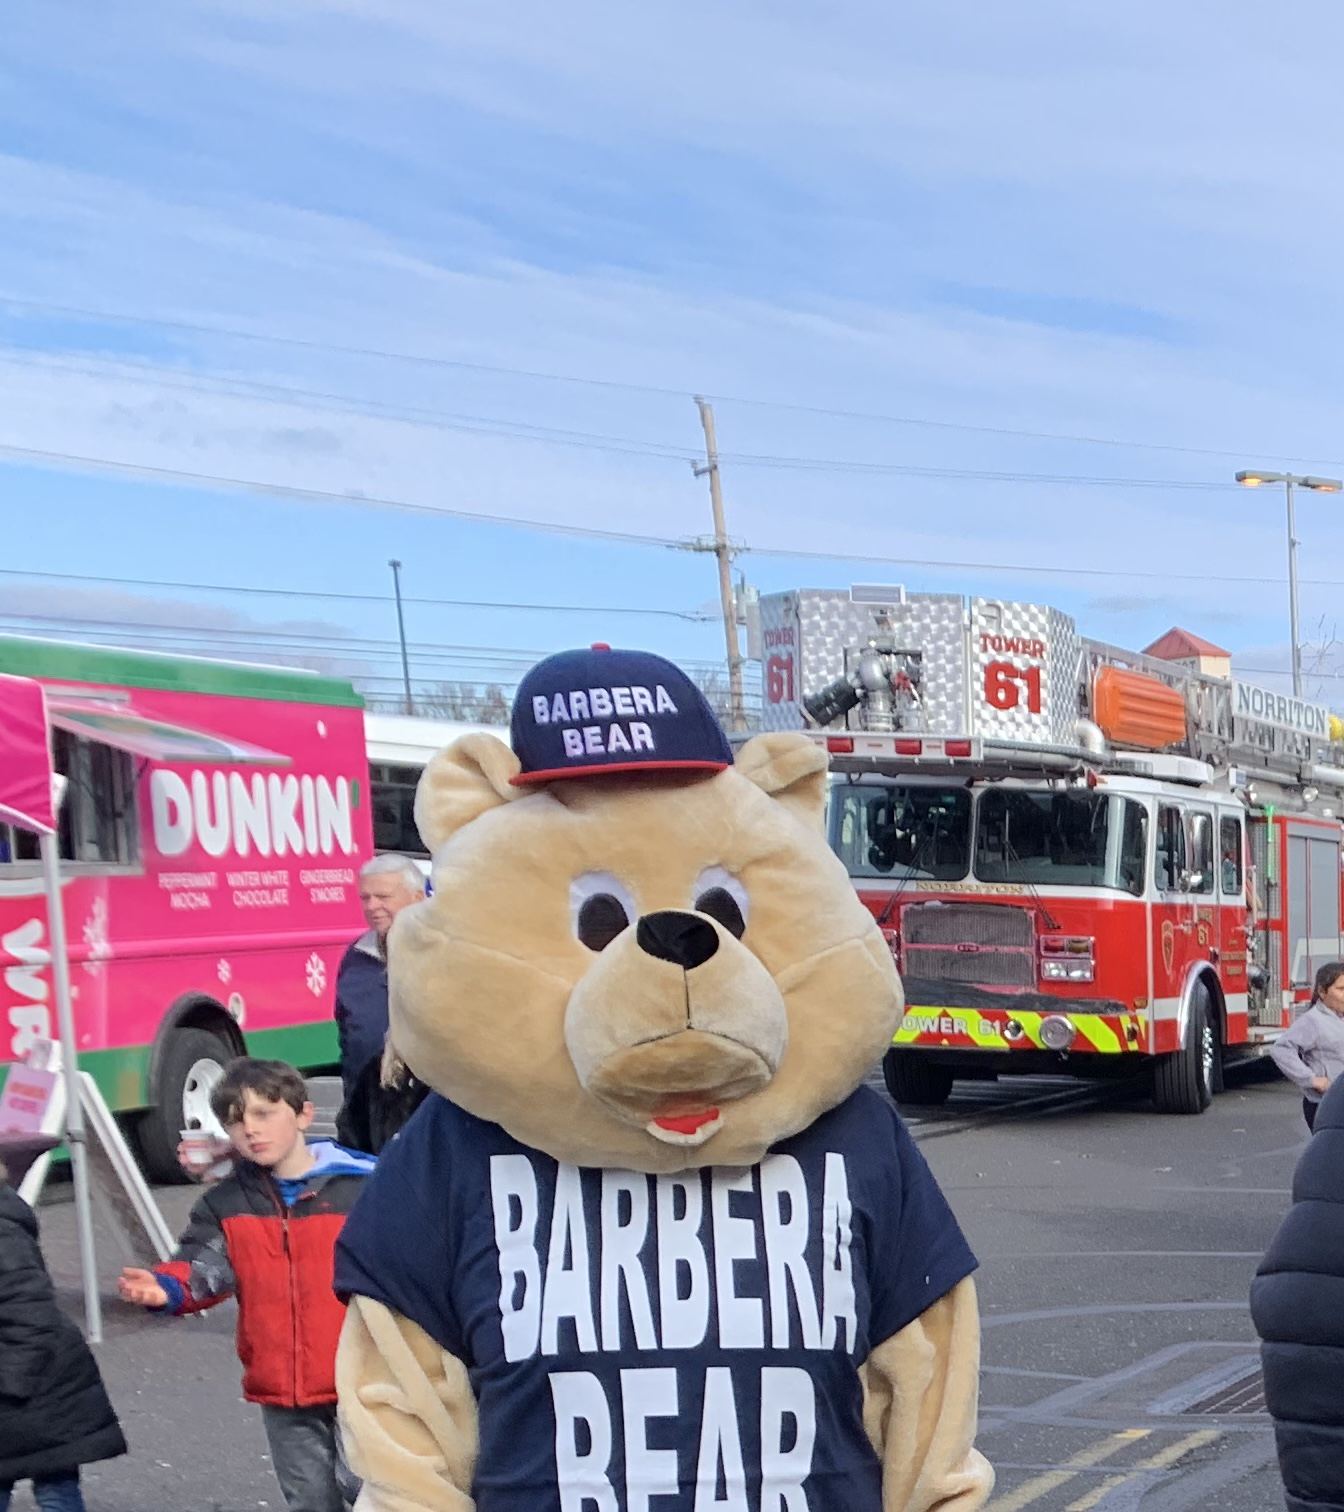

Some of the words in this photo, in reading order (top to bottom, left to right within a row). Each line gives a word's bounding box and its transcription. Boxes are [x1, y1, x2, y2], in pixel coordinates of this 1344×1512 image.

[979, 633, 1045, 660] TOWER
[766, 653, 795, 704] 61
[983, 660, 1042, 714] 61
[532, 684, 678, 726] BARBERA
[1237, 682, 1327, 733] NORRITON
[561, 721, 656, 758] BEAR
[226, 871, 260, 887] WINTER
[261, 870, 290, 886] WHITE
[170, 892, 212, 910] MOCHA
[232, 889, 290, 908] CHOCOLATE
[902, 1015, 968, 1035] OWER
[978, 1018, 1001, 1037] 61
[489, 1151, 858, 1364] BARBERA
